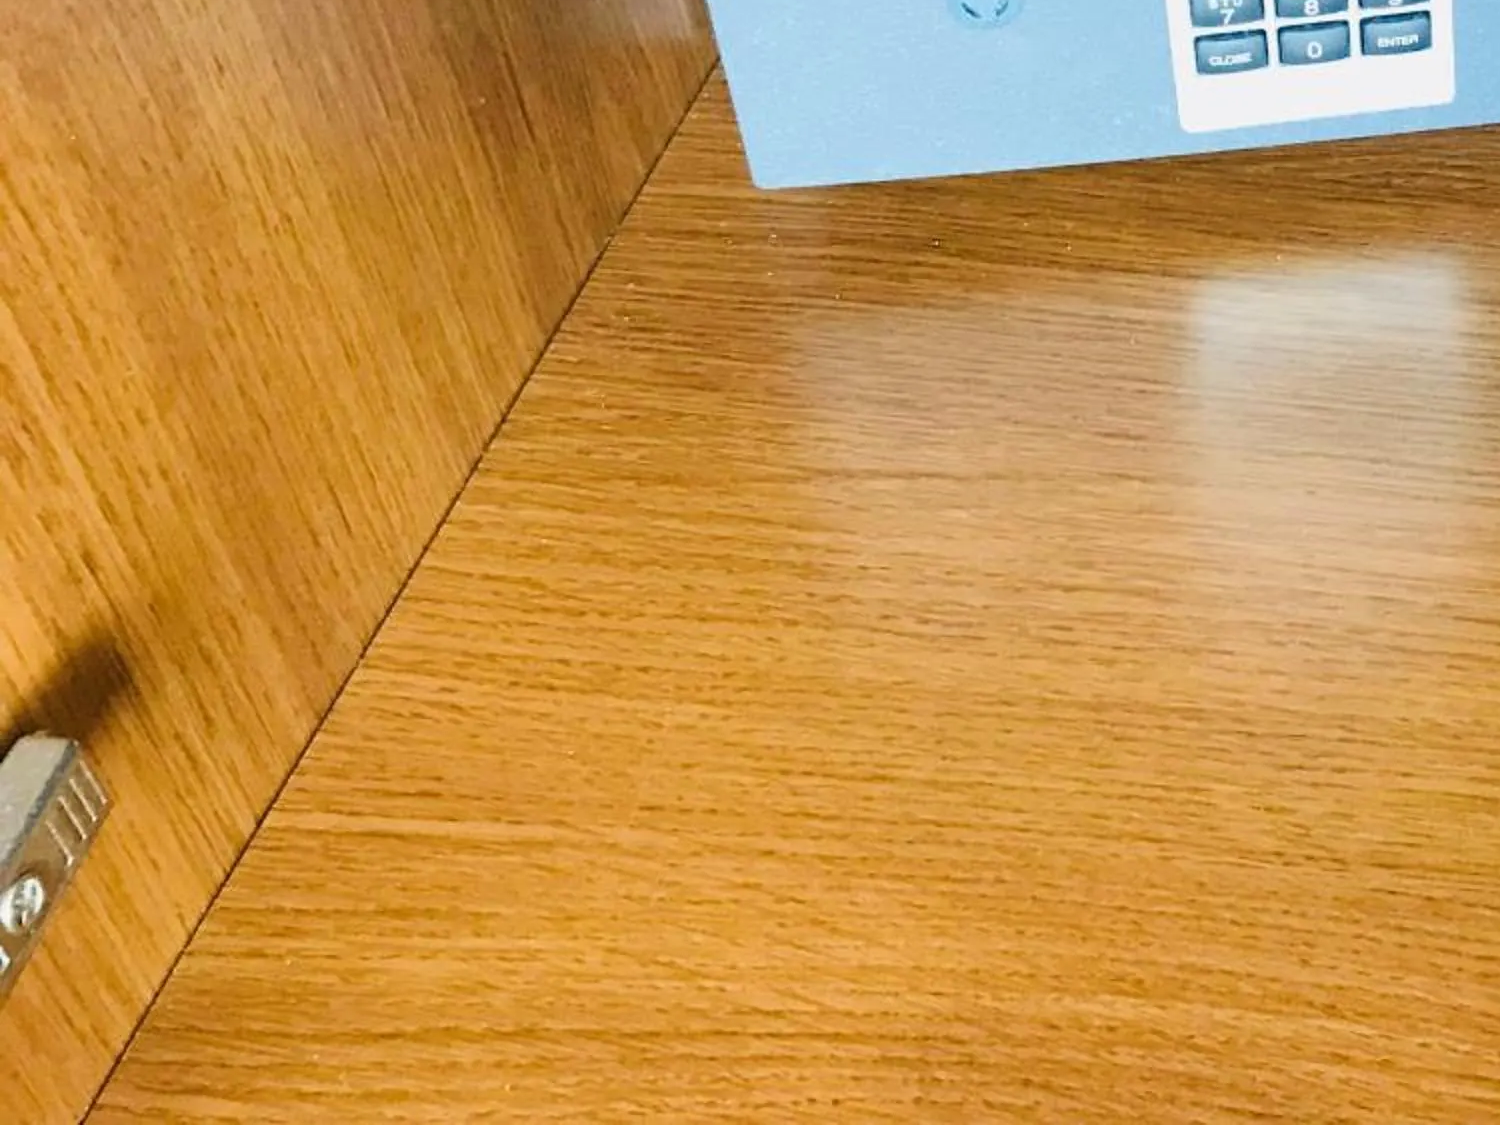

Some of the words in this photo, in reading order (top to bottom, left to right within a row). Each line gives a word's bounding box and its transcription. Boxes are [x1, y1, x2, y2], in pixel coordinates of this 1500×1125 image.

[1219, 8, 1235, 26] 7
[1377, 33, 1420, 48] ENTER
[1306, 41, 1323, 59] 0
